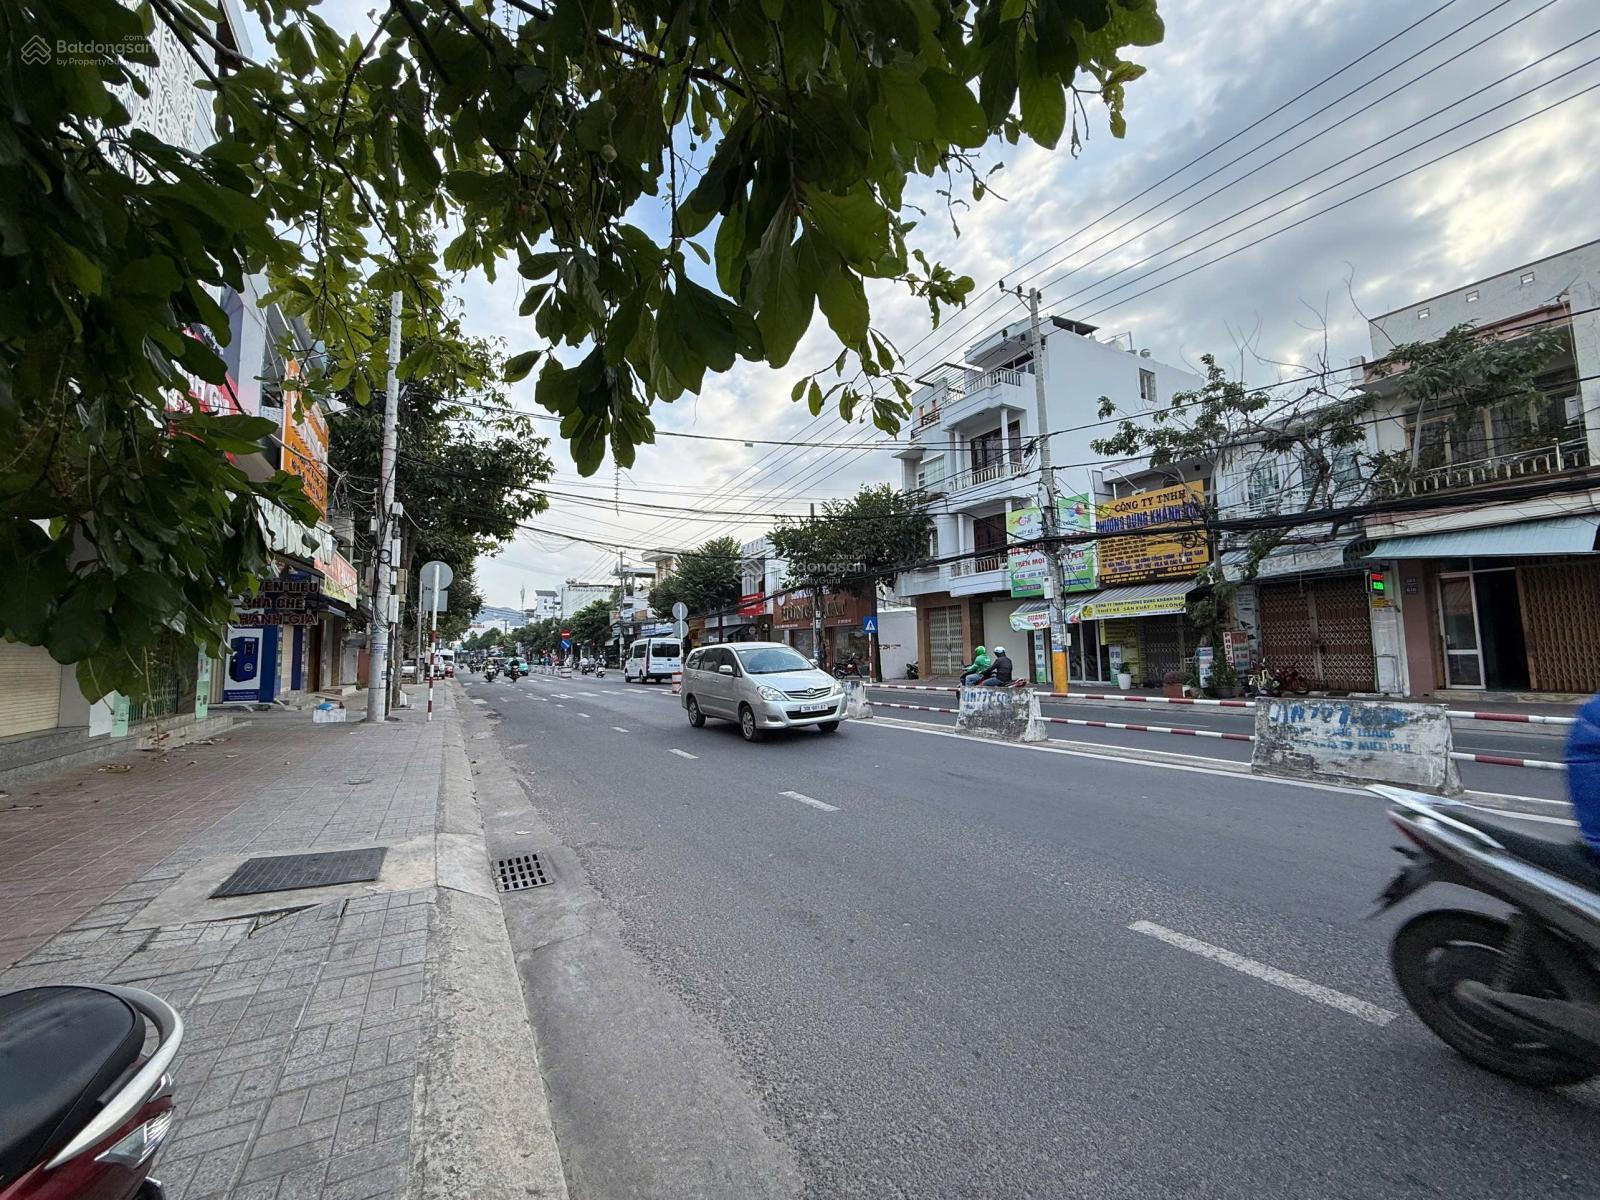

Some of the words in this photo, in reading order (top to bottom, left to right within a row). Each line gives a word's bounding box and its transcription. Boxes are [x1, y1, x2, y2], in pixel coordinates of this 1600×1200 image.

[1114, 500, 1139, 513] CÔNG
[1141, 496, 1154, 507] TY
[1156, 489, 1186, 504] TNHH
